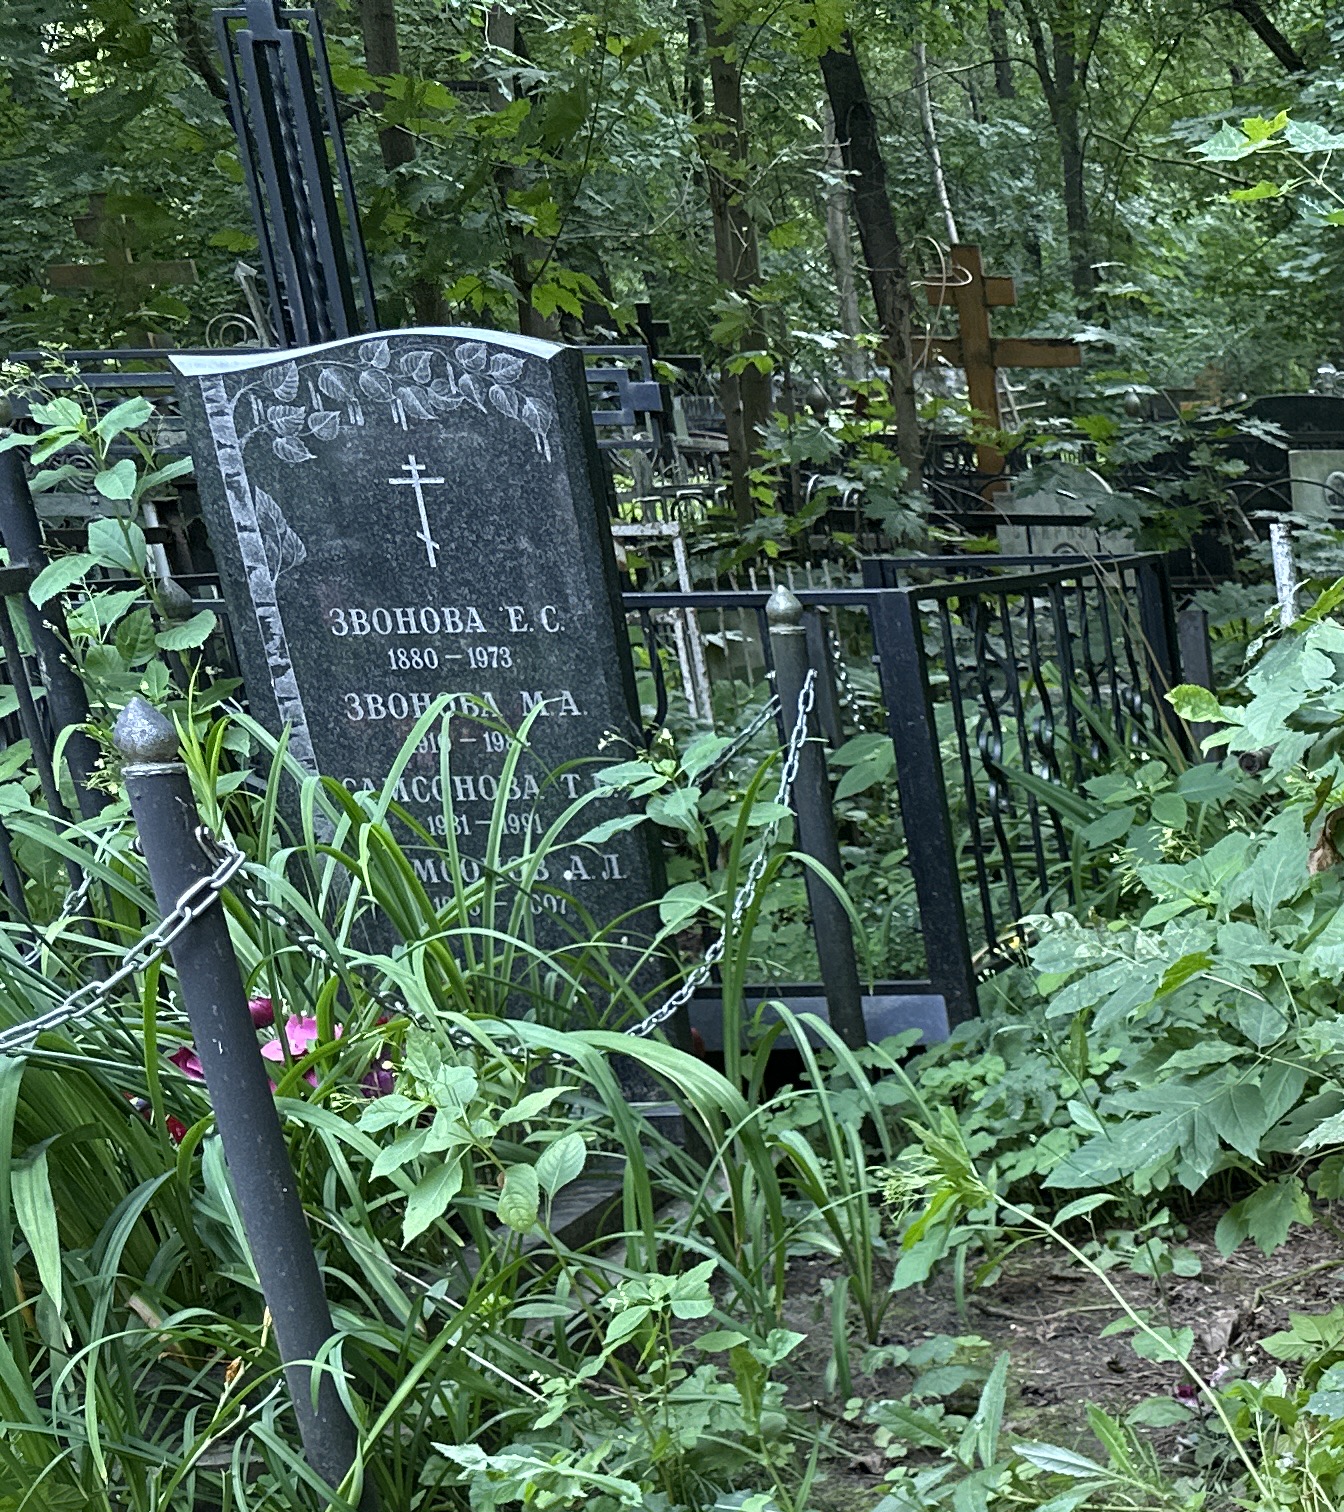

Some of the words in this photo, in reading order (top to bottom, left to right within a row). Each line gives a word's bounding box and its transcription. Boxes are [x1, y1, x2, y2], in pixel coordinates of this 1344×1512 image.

[329, 607, 487, 636] ЗВОНОВА
[387, 647, 439, 670] 1880
[466, 646, 513, 669] 1973
[345, 691, 504, 721] ЗВОНОВА
[412, 731, 452, 754] 91
[483, 730, 532, 754] 198
